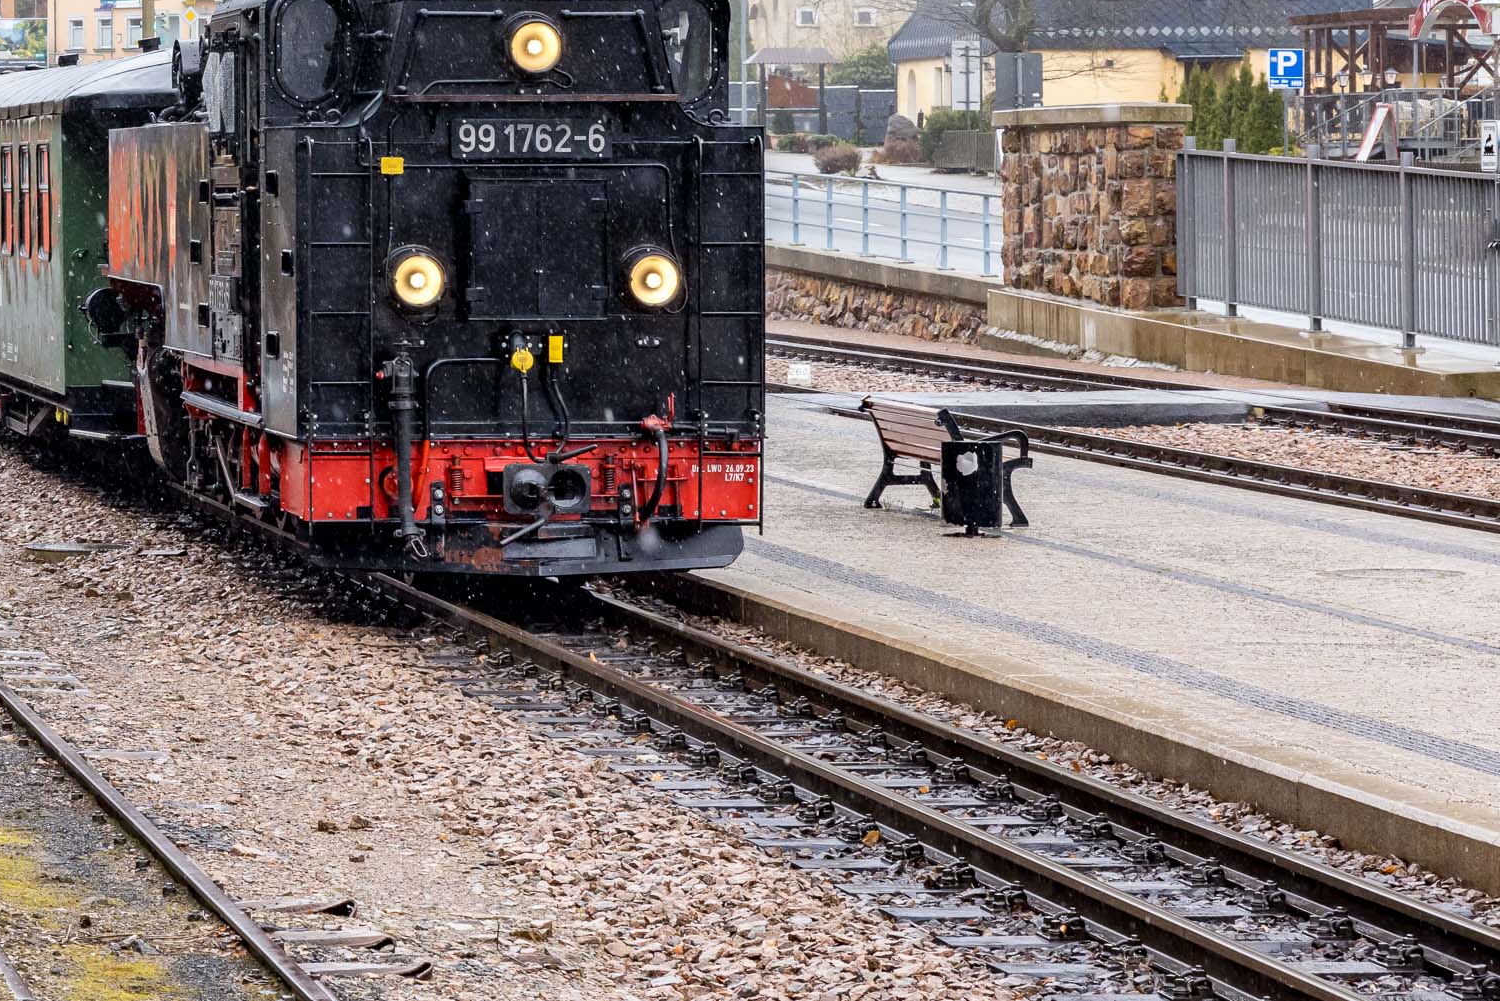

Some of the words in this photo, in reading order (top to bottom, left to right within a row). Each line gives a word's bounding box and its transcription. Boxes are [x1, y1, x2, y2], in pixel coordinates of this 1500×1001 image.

[1277, 51, 1298, 76] P
[458, 123, 496, 153] 99
[503, 123, 606, 153] 1762-6
[725, 464, 755, 473] 26.09.23
